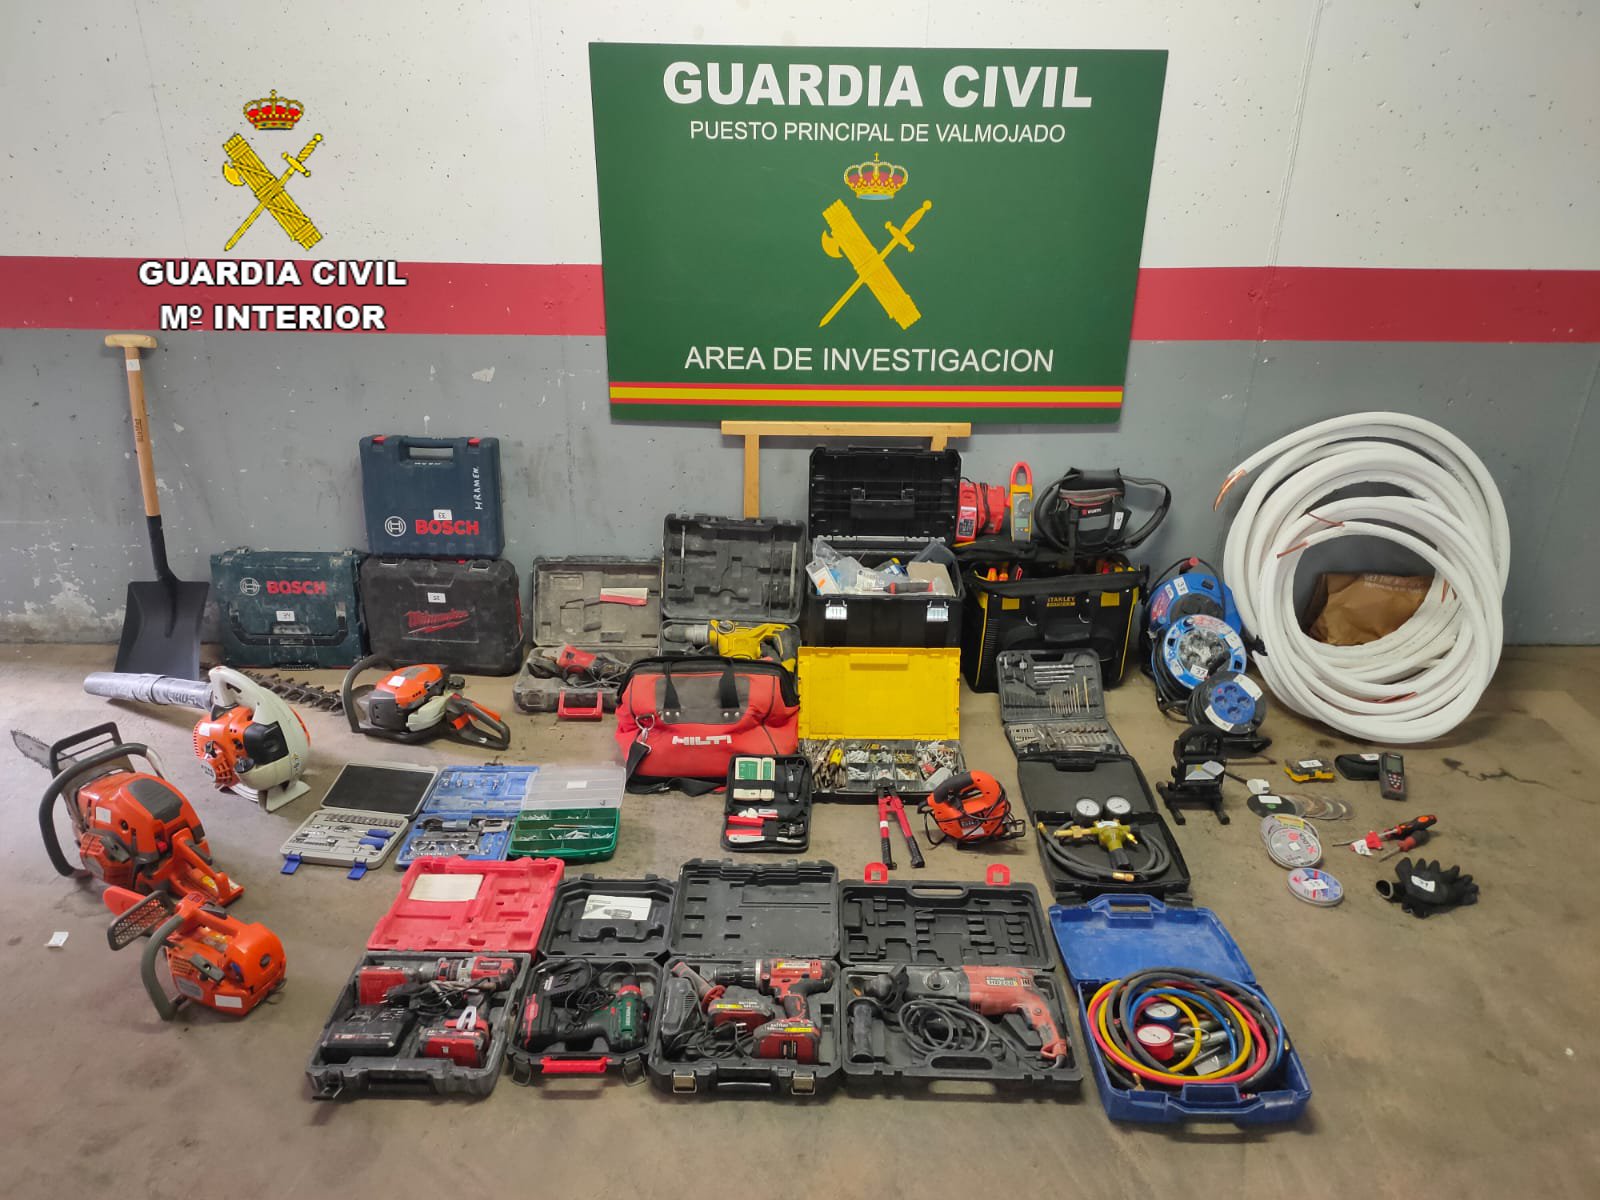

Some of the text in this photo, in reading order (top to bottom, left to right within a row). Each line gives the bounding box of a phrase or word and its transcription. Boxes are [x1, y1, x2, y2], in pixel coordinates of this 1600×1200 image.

[662, 60, 1093, 109] GUARDIA CIVIL
[690, 120, 1066, 143] PUESTO PRINCIPAL DE VALMOJADO
[684, 345, 1054, 373] AREA DE INVESTIGACION
[415, 519, 479, 536] BOSCH
[265, 580, 328, 596] BOSCH
[671, 734, 733, 746] HILTI
